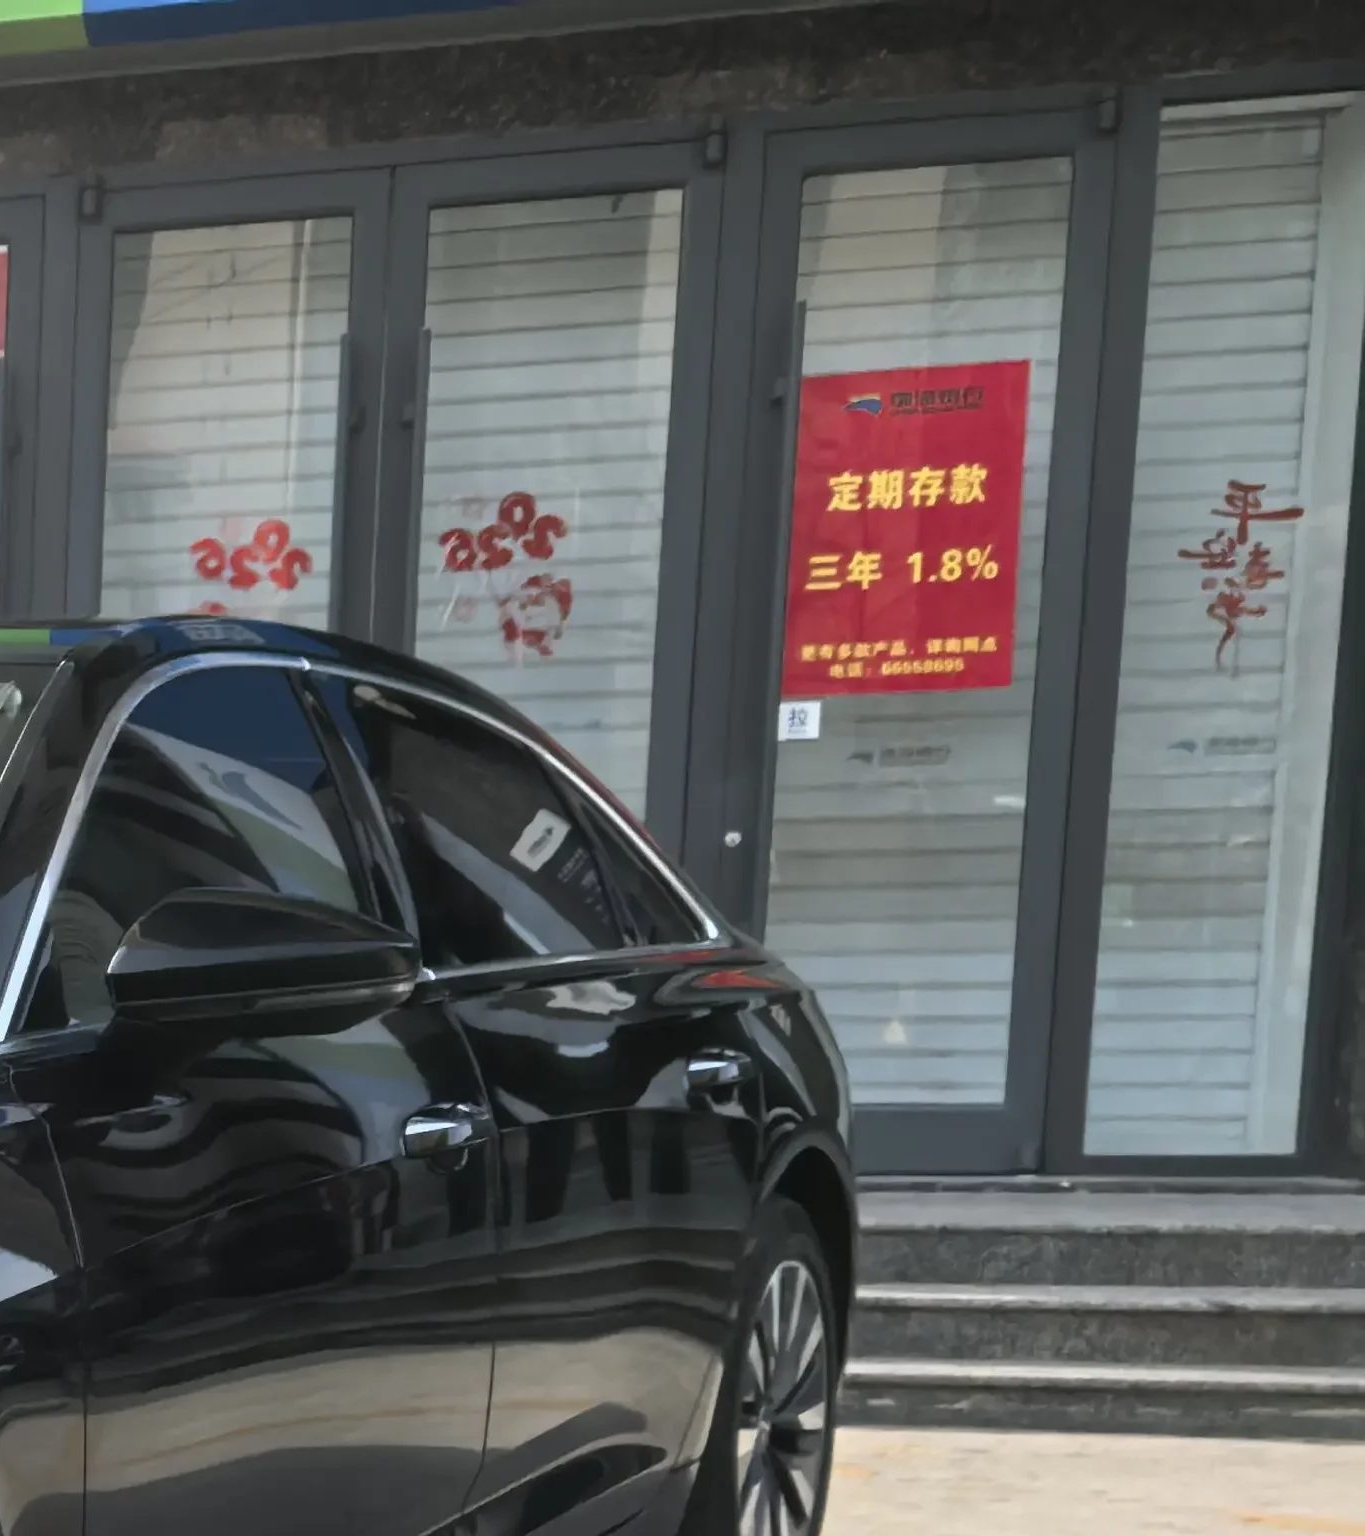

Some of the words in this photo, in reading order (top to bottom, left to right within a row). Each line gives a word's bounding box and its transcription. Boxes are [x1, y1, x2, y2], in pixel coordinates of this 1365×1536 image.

[825, 463, 989, 512] 定期存款
[804, 551, 883, 591] 三年
[906, 544, 1000, 583] 1.8%
